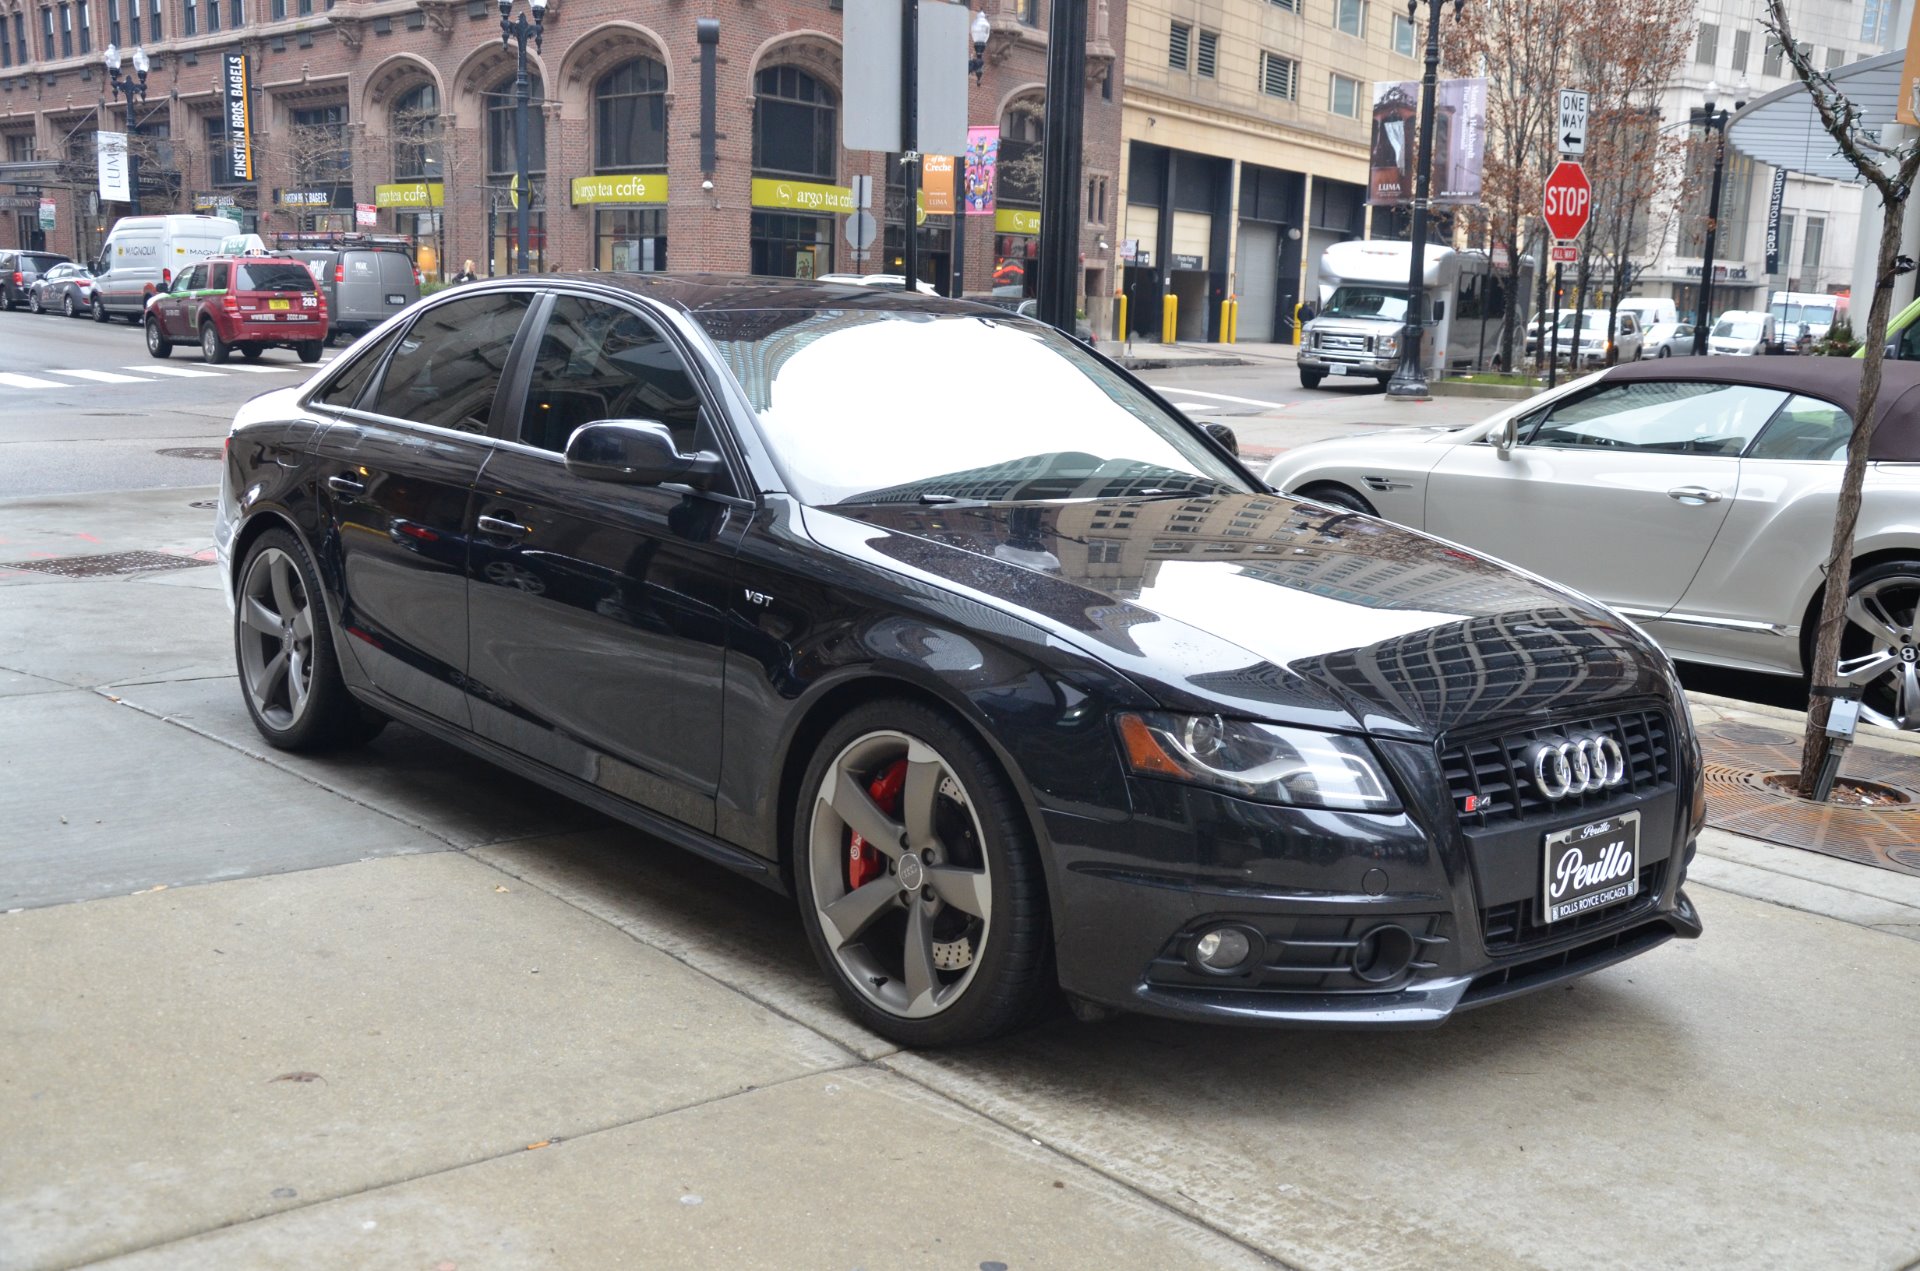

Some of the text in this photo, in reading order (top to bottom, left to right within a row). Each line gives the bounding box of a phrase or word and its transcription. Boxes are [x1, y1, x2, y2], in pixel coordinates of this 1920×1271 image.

[1563, 95, 1584, 112] ONE
[229, 57, 247, 178] EINSTEIN BROS. BAGELS
[1562, 113, 1584, 129] WAY
[925, 162, 952, 172] Creche
[390, 190, 401, 202] tea
[403, 184, 427, 202] café
[580, 176, 645, 201] argo tea café
[1378, 183, 1401, 191] LUMA
[309, 192, 327, 203] BAGELS
[797, 190, 823, 208] argo
[825, 191, 838, 206] tea
[1547, 186, 1588, 217] STOP
[126, 246, 156, 256] MAGNOLIA
[1766, 229, 1779, 256] rack
[1553, 249, 1575, 259] ALL WAY
[1729, 265, 1748, 279] rack
[302, 297, 317, 307] 203
[1580, 821, 1611, 839] Perillo
[1550, 840, 1632, 898] Perillo
[1560, 902, 1578, 916] ROLLS
[1579, 895, 1599, 910] ROYCE
[1599, 886, 1626, 903] CHICAGO
